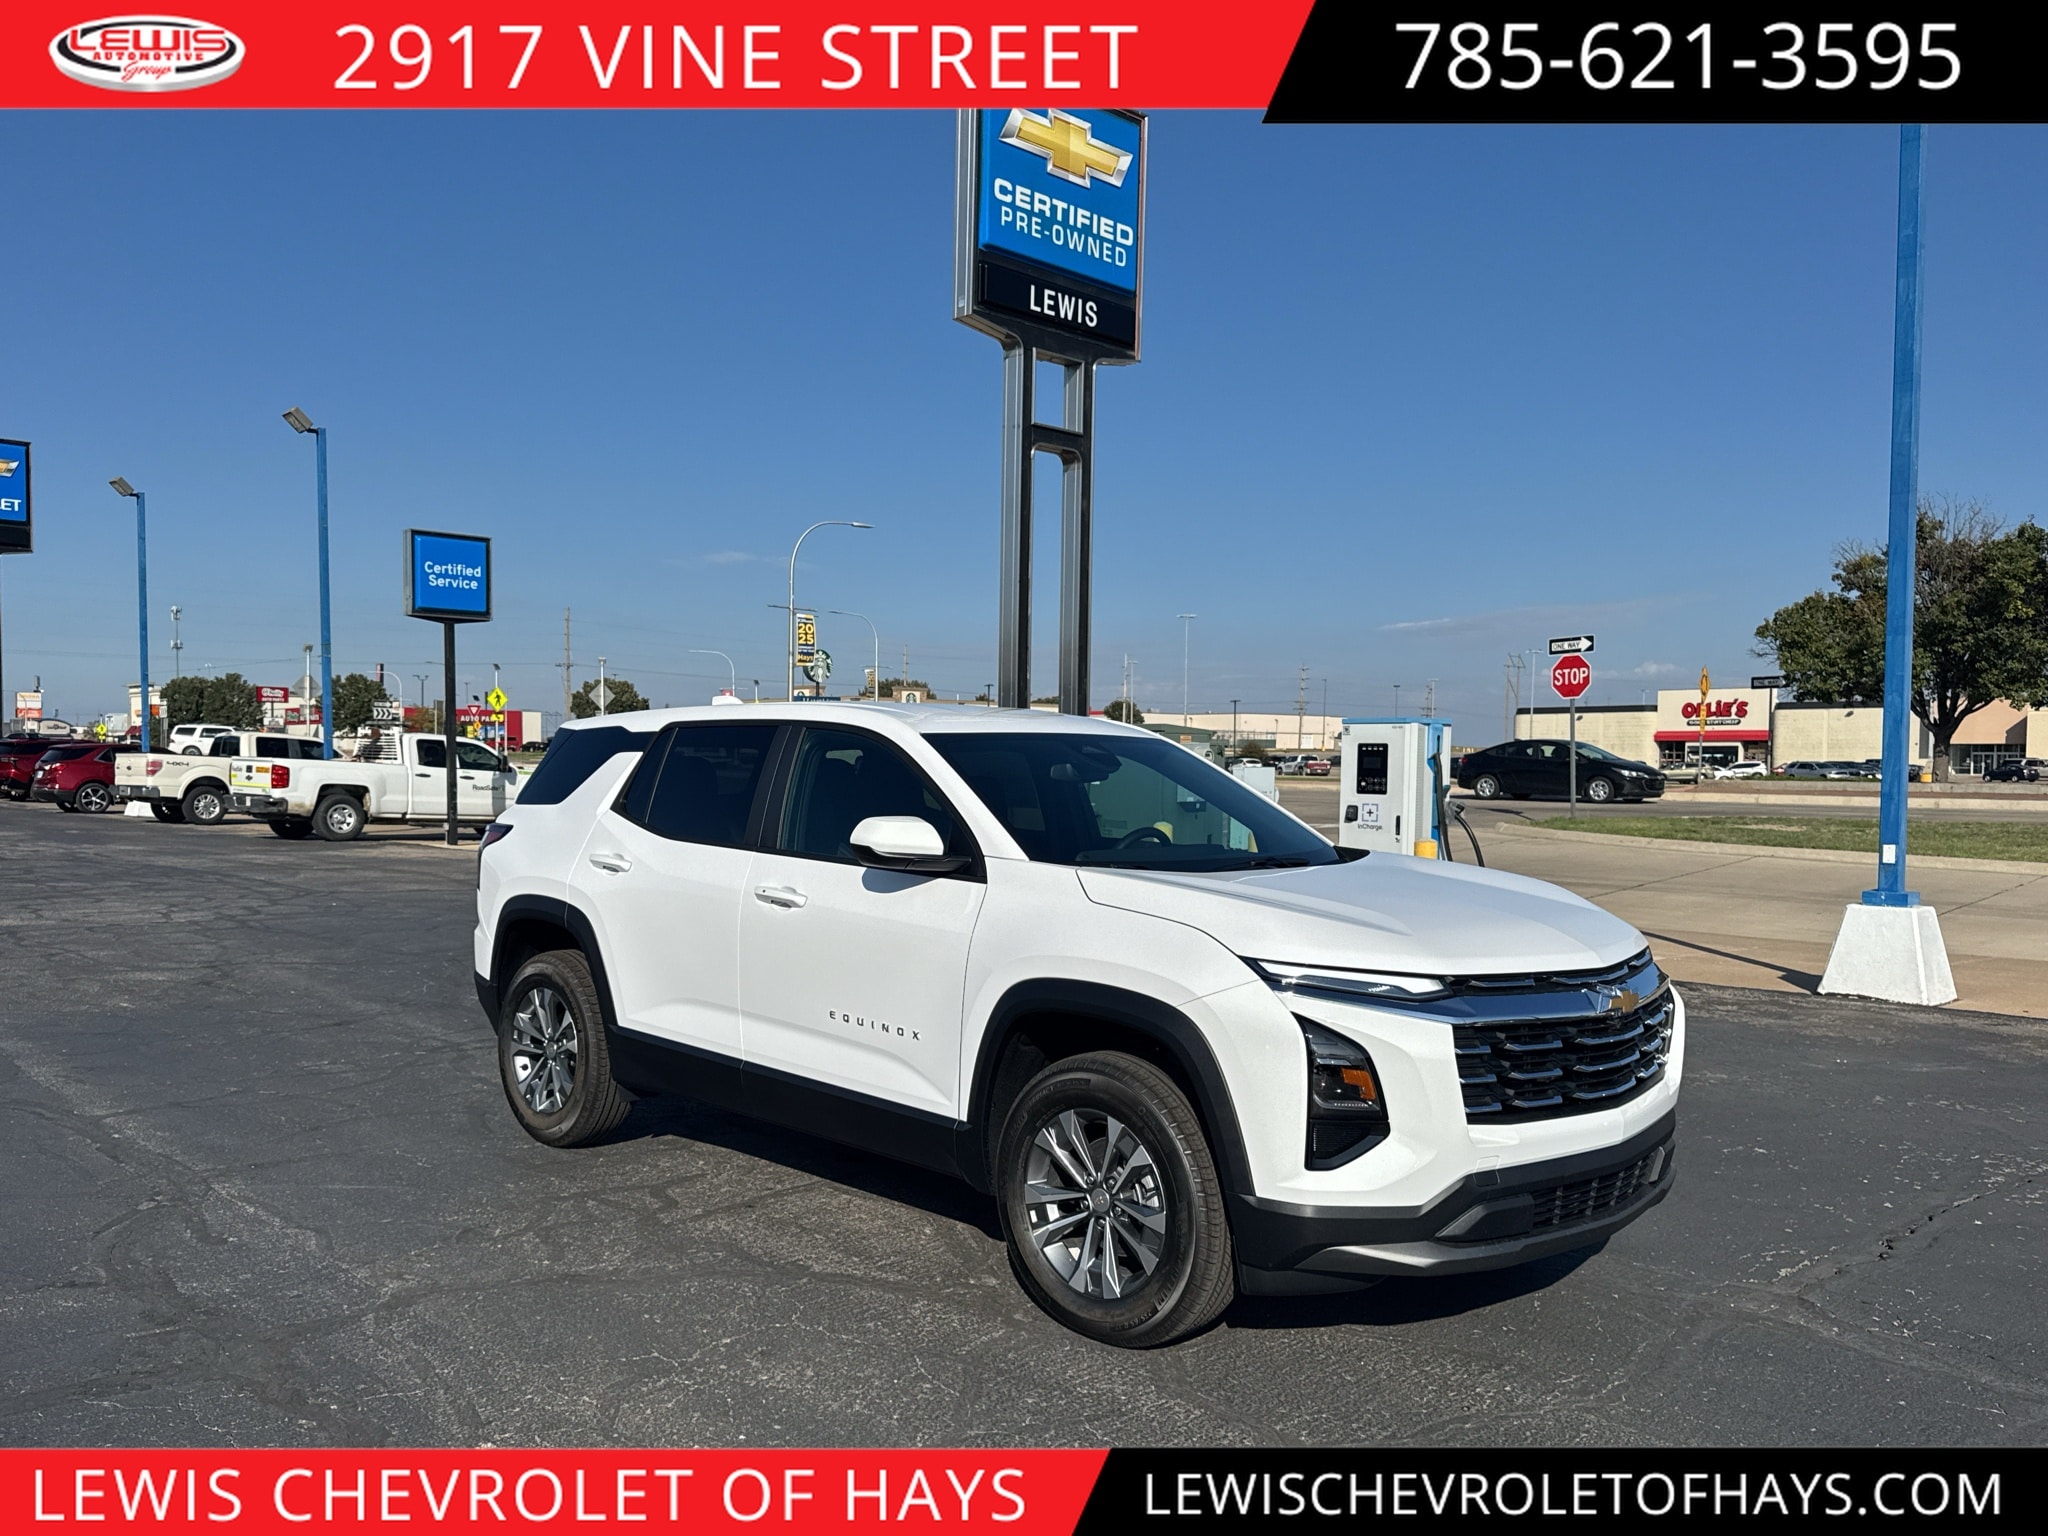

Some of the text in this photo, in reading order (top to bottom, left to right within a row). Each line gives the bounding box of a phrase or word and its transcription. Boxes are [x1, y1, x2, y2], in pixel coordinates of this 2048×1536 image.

[993, 177, 1134, 247] CERTIFIED
[1000, 206, 1128, 267] PRE-OWNED
[1029, 284, 1098, 327] LEWIS
[0, 498, 22, 511] ET
[424, 561, 482, 577] Certified
[428, 574, 479, 590] Service
[1552, 641, 1580, 650] ONE WAY
[1554, 667, 1589, 686] STOP
[829, 1010, 920, 1041] EQUINOX
